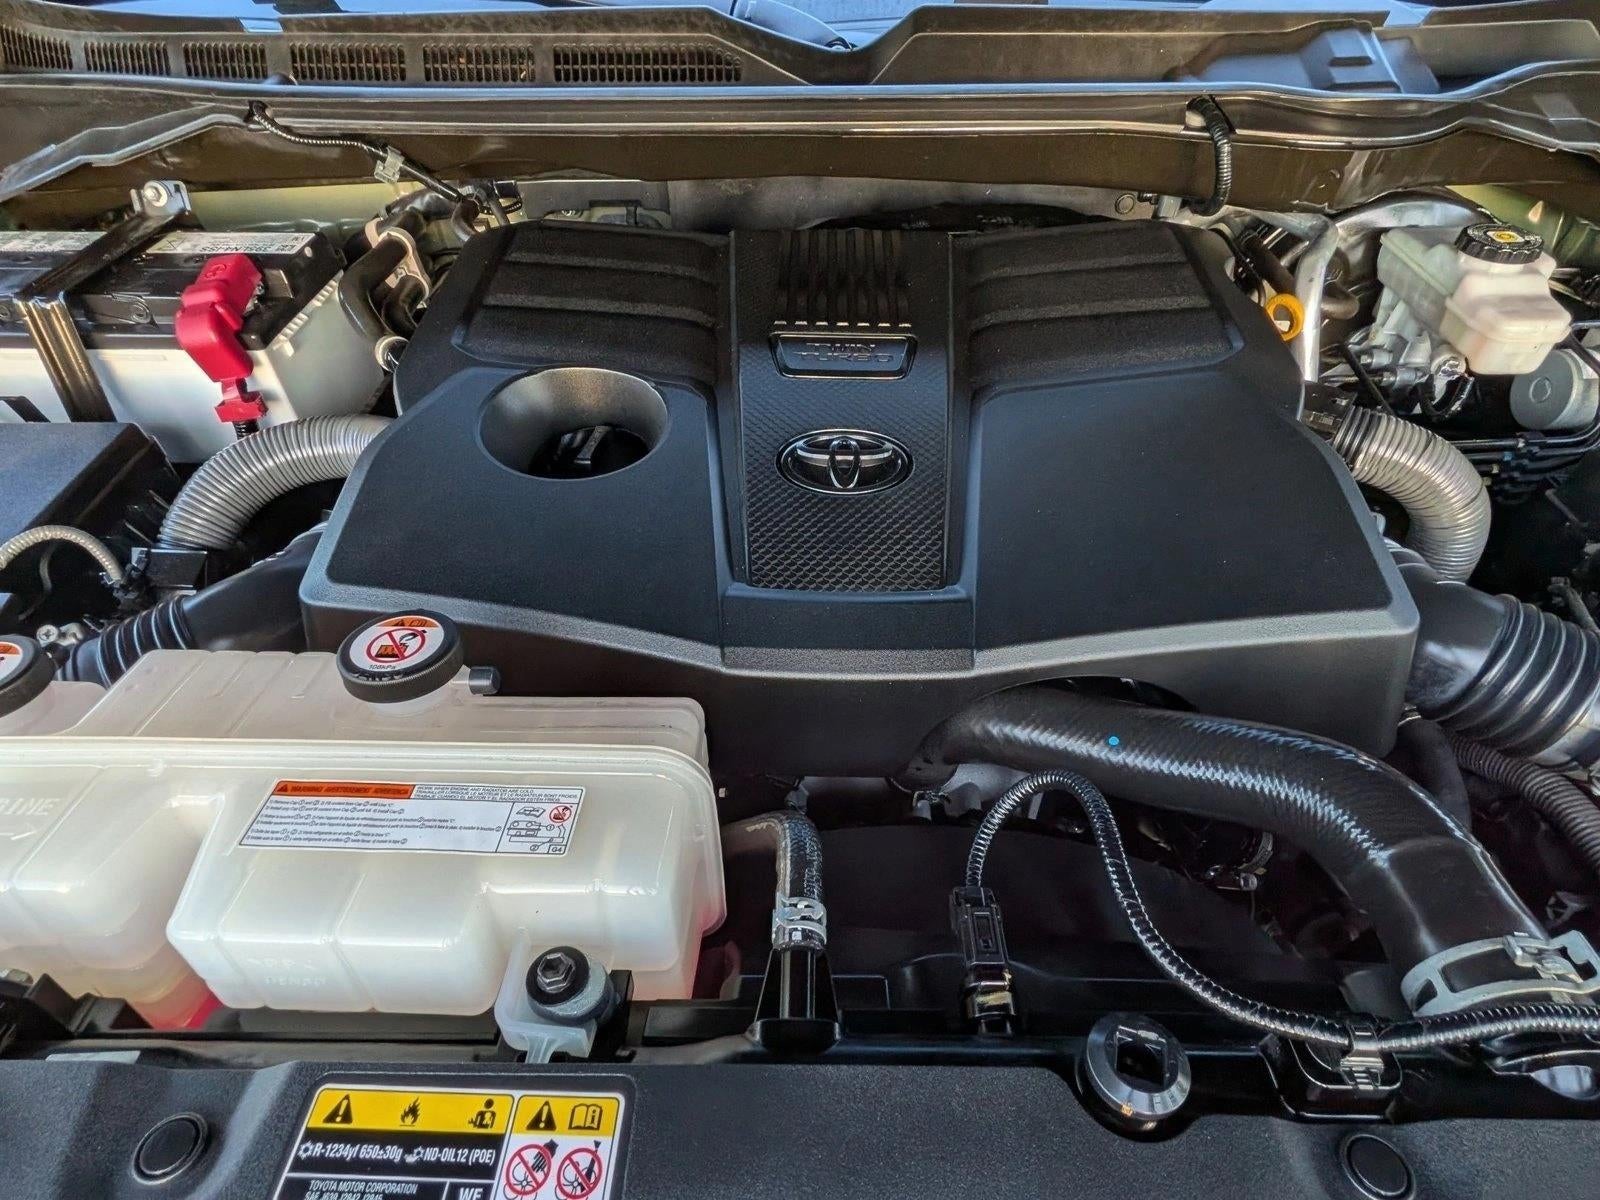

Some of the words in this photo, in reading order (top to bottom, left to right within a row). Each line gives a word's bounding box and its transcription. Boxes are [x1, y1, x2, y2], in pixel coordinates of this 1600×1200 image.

[312, 1142, 357, 1162] R-1234yf
[358, 1144, 403, 1164] 650±30g
[423, 1147, 469, 1163] ND-OIL12
[468, 1148, 496, 1167] (POE)
[308, 1179, 338, 1191] TOYOTA
[338, 1180, 365, 1193] MOTOR
[365, 1181, 418, 1195] CORPORATION
